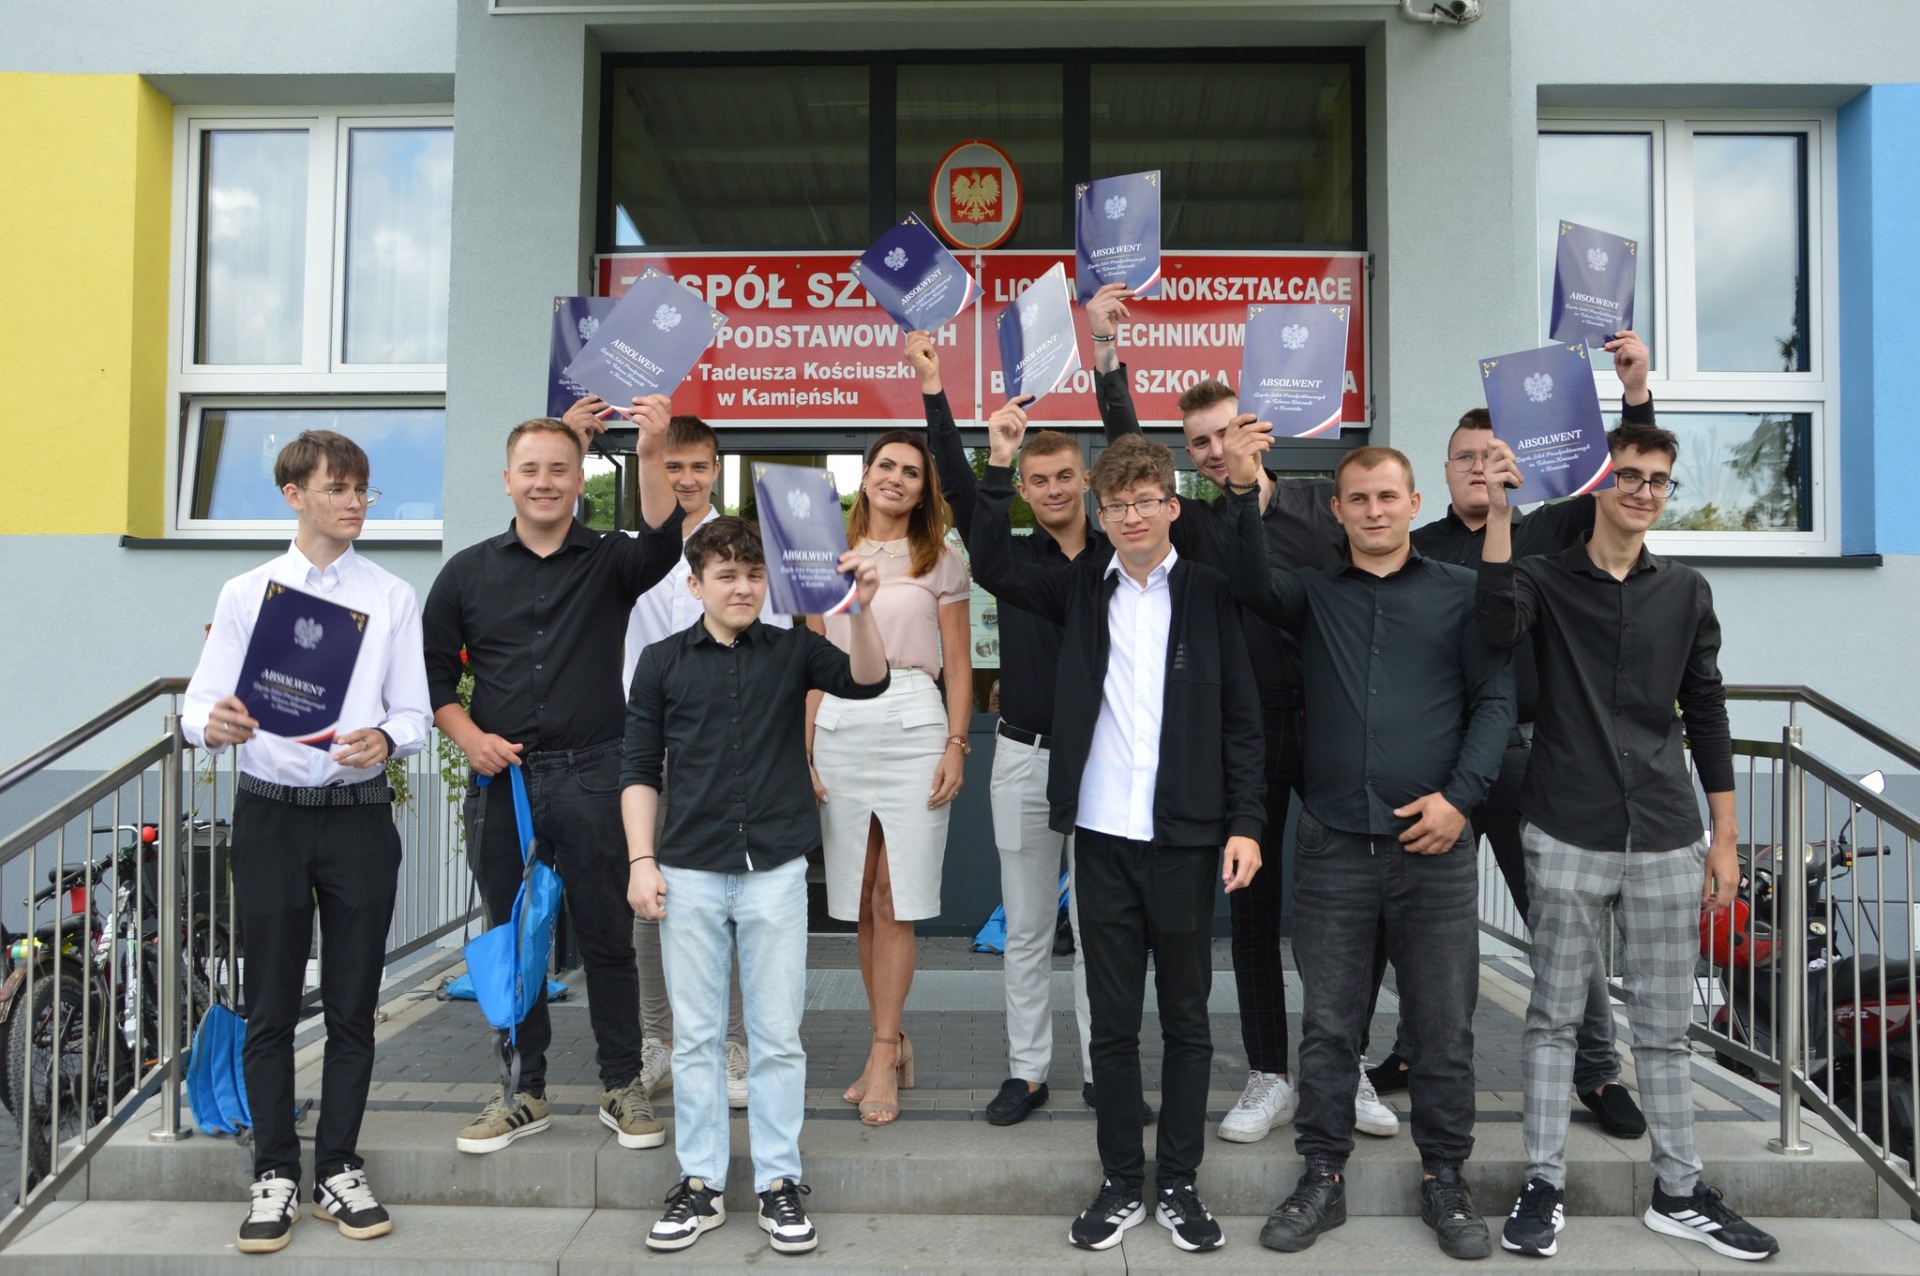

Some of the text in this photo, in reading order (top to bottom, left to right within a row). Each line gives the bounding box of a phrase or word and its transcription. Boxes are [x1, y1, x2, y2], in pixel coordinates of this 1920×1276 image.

[1090, 243, 1142, 258] ABSOLWENT
[621, 265, 793, 309] SPÓŁ
[901, 268, 942, 306] ABSOLWENT
[1118, 277, 1352, 304] NOKSZTAŁCĄCE
[1569, 291, 1620, 310] ABSOLWENT
[706, 324, 957, 348] PODSTAWOWH
[1116, 323, 1246, 347] ECHNIKUM
[611, 339, 665, 376] ABSOLWENT
[1014, 333, 1058, 373] ABSOLWENT
[698, 363, 797, 381] Tadeusza
[803, 361, 916, 380] Kościuszki
[1259, 378, 1323, 389] ABSOLWENT
[717, 387, 859, 407] w Kamieńsku
[1517, 429, 1583, 450] ABSOLWENT
[782, 549, 834, 562] ABSOLWENT
[260, 668, 327, 698] ABSOLWENT
